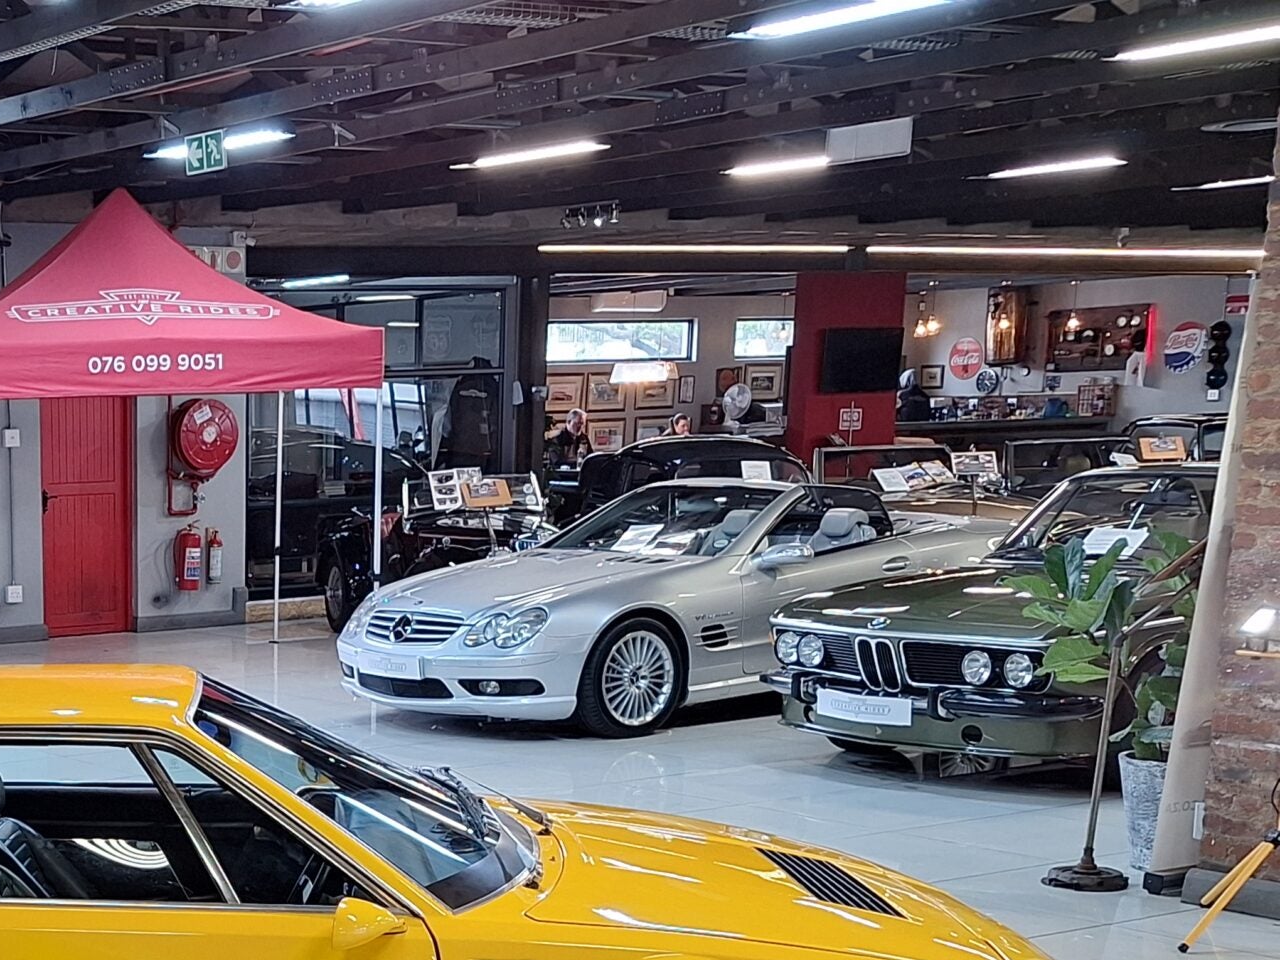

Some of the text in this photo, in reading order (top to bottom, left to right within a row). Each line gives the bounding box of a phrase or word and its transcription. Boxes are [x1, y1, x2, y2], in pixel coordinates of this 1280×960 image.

[27, 302, 258, 318] CREATIVE RIDES
[88, 353, 224, 374] 076 099 9051
